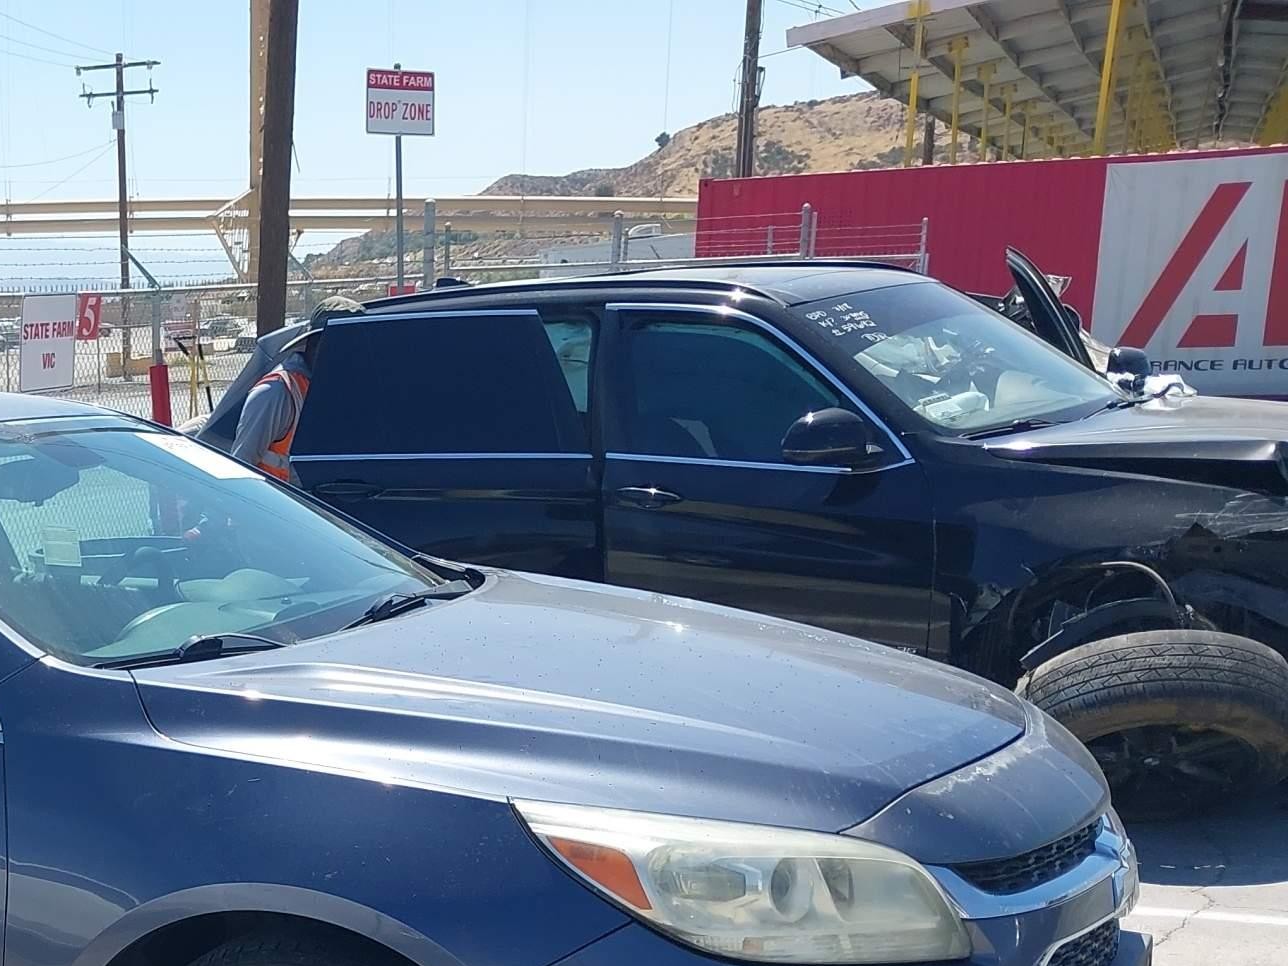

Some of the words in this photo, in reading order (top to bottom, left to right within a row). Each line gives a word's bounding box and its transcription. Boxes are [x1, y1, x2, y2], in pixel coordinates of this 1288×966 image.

[369, 73, 401, 87] STATE
[402, 75, 432, 88] FARM
[369, 100, 398, 120] DROP
[401, 102, 432, 121] ZONE
[82, 297, 97, 336] 5
[23, 322, 50, 340] STATE
[51, 320, 74, 338] FARM
[42, 352, 56, 369] VIC
